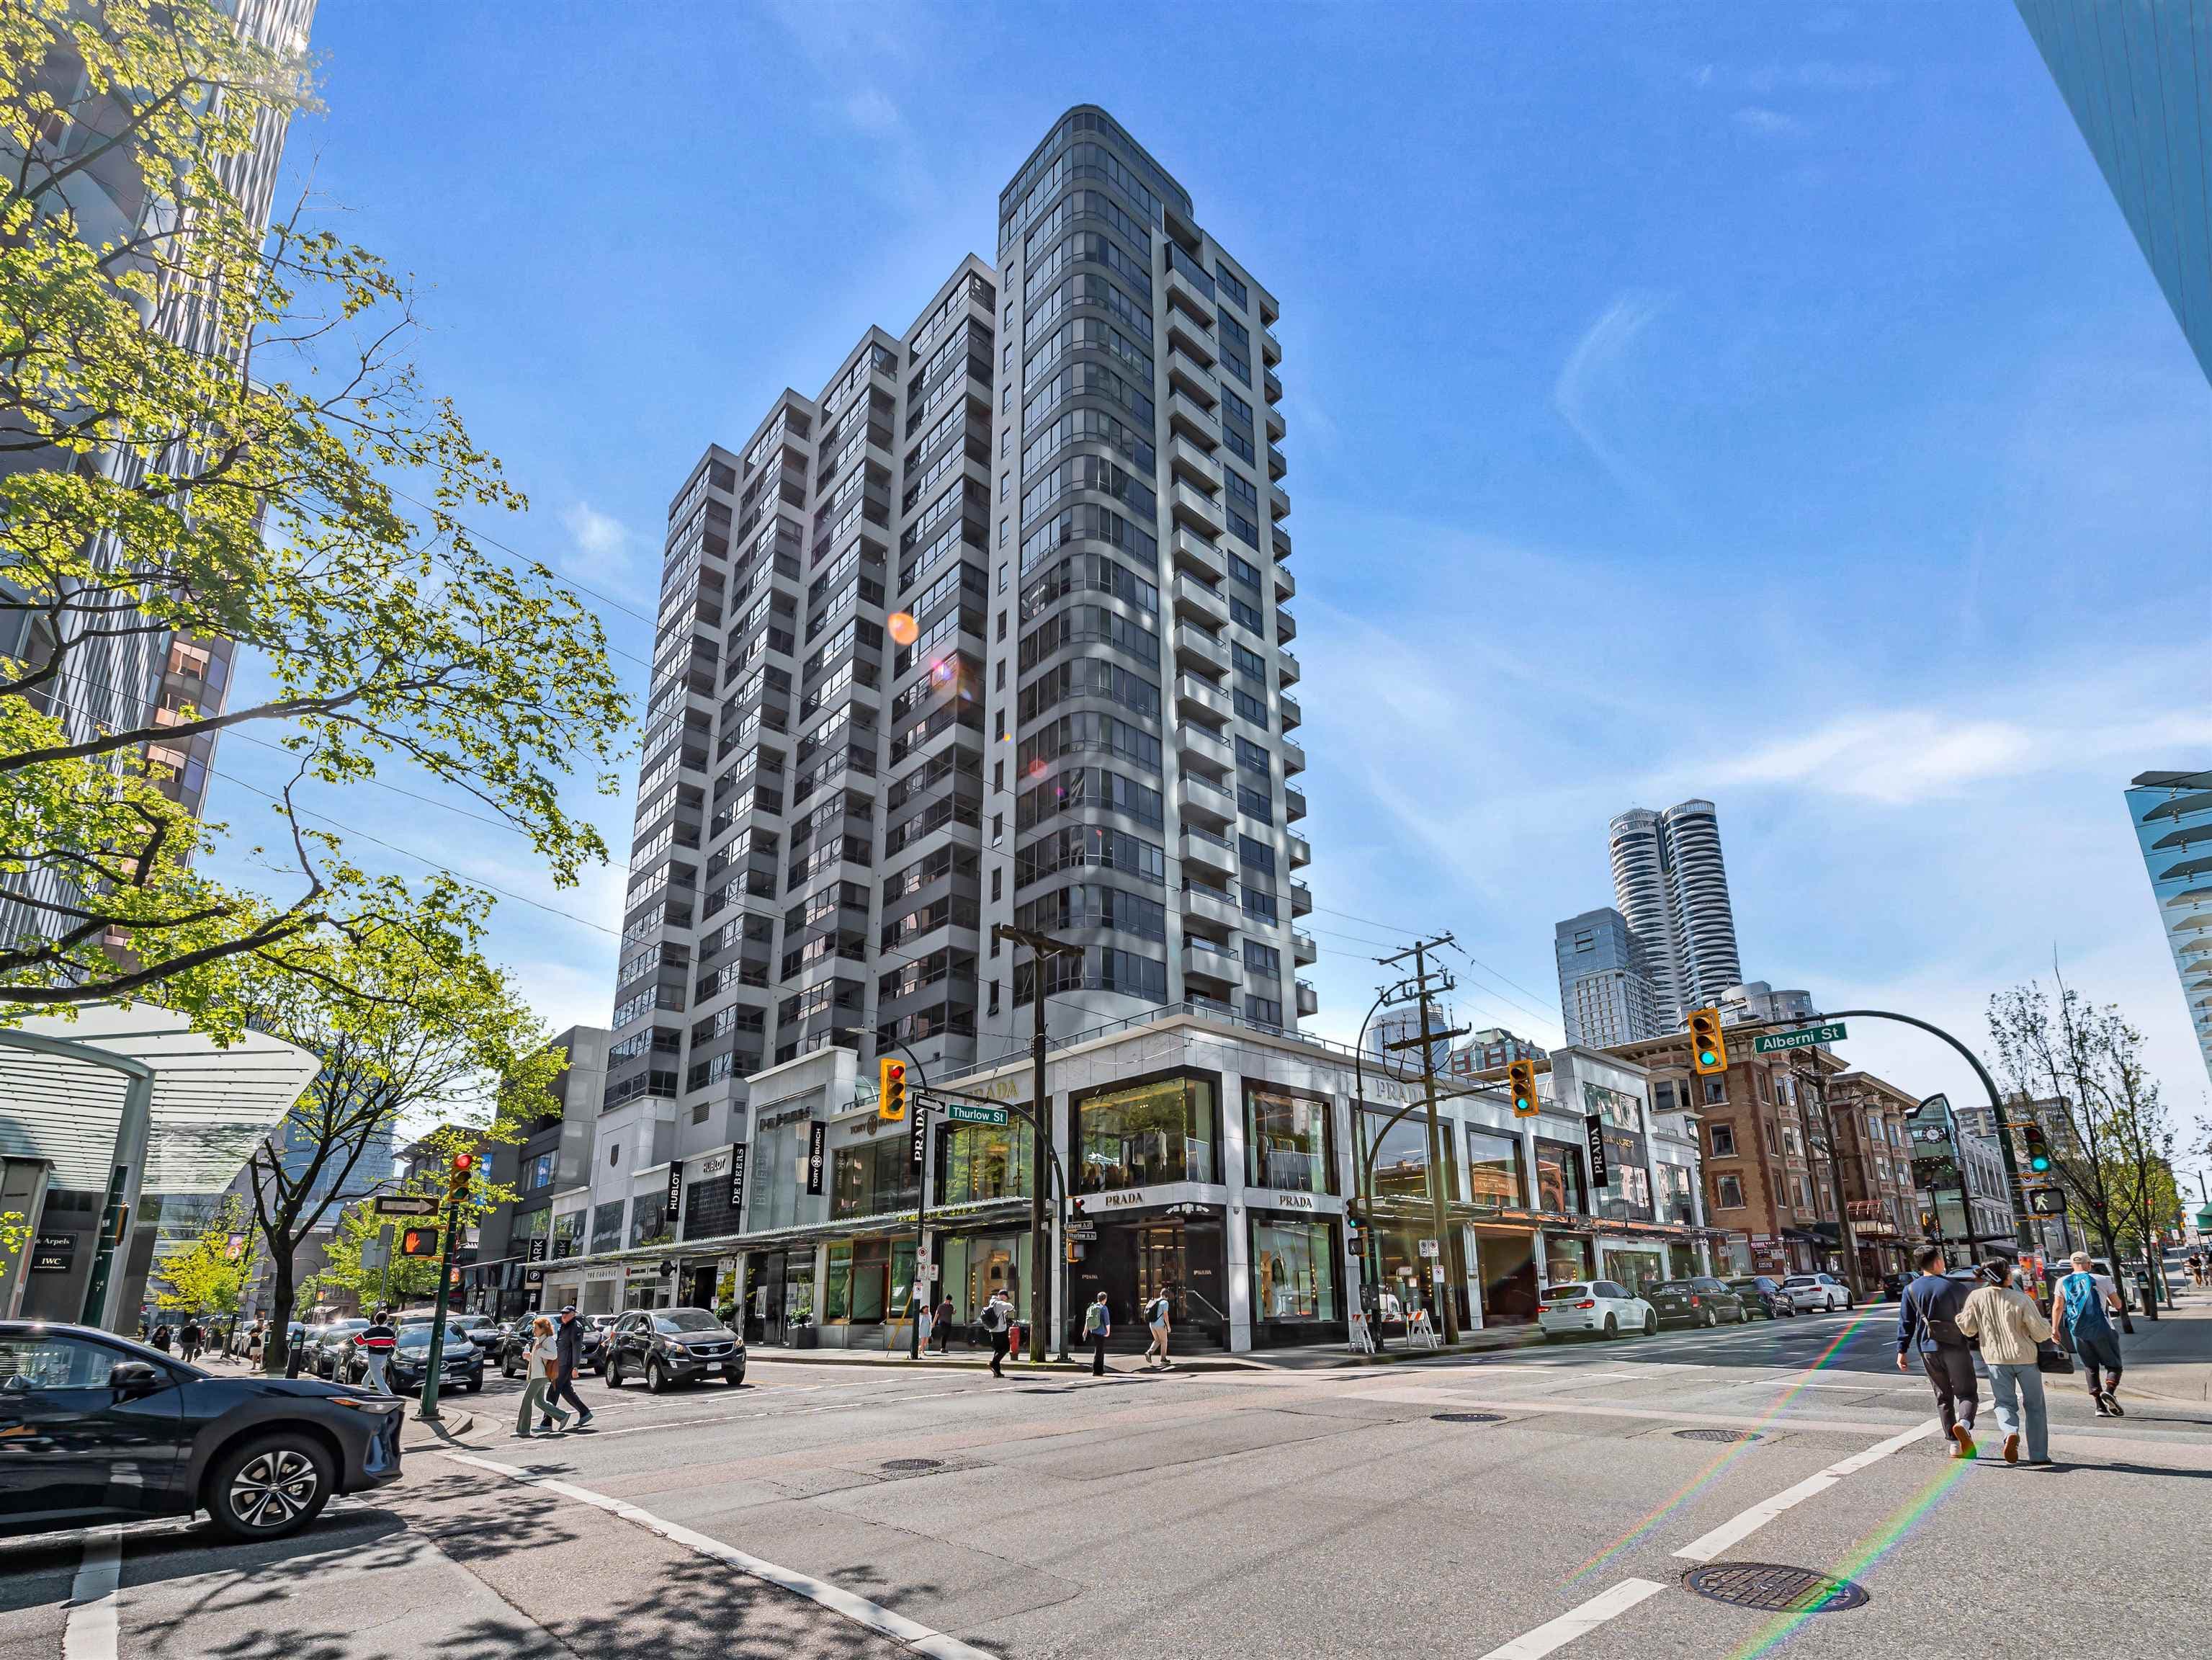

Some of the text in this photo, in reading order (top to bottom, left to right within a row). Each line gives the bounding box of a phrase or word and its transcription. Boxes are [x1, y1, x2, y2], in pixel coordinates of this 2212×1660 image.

[1763, 1027, 1839, 1050] Alberni St
[953, 1107, 1003, 1123] Thurlow St
[914, 1108, 925, 1161] PRADA
[1590, 1128, 1603, 1174] PRADA
[703, 1158, 726, 1173] HUBLOT
[733, 1148, 744, 1205] DE BEERS
[670, 1172, 680, 1210] HUBLOT
[1106, 1192, 1143, 1206] PRADA
[1279, 1195, 1312, 1208] PRADA
[533, 1240, 543, 1262] ARK
